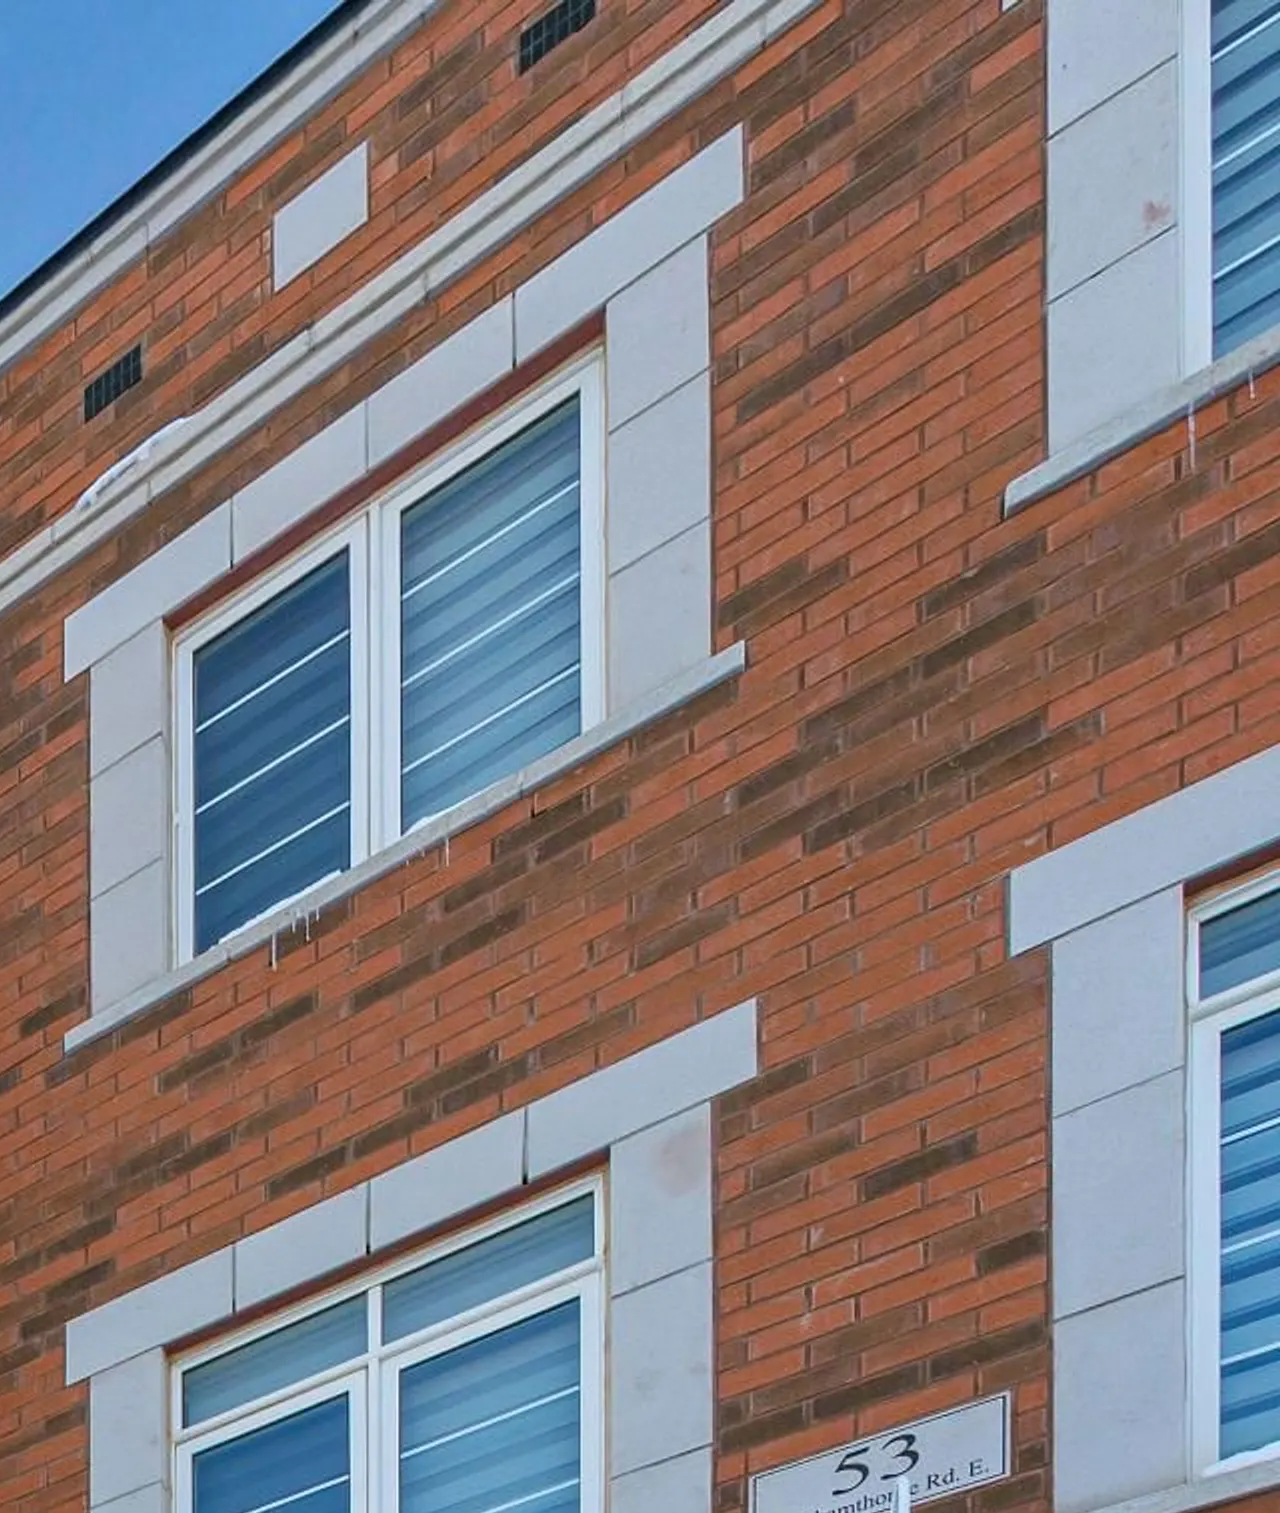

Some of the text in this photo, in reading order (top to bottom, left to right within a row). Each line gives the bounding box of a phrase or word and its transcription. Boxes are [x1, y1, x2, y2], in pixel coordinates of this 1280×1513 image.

[832, 1433, 919, 1496] 53
[926, 1469, 960, 1492] Rd.
[968, 1458, 990, 1478] E.
